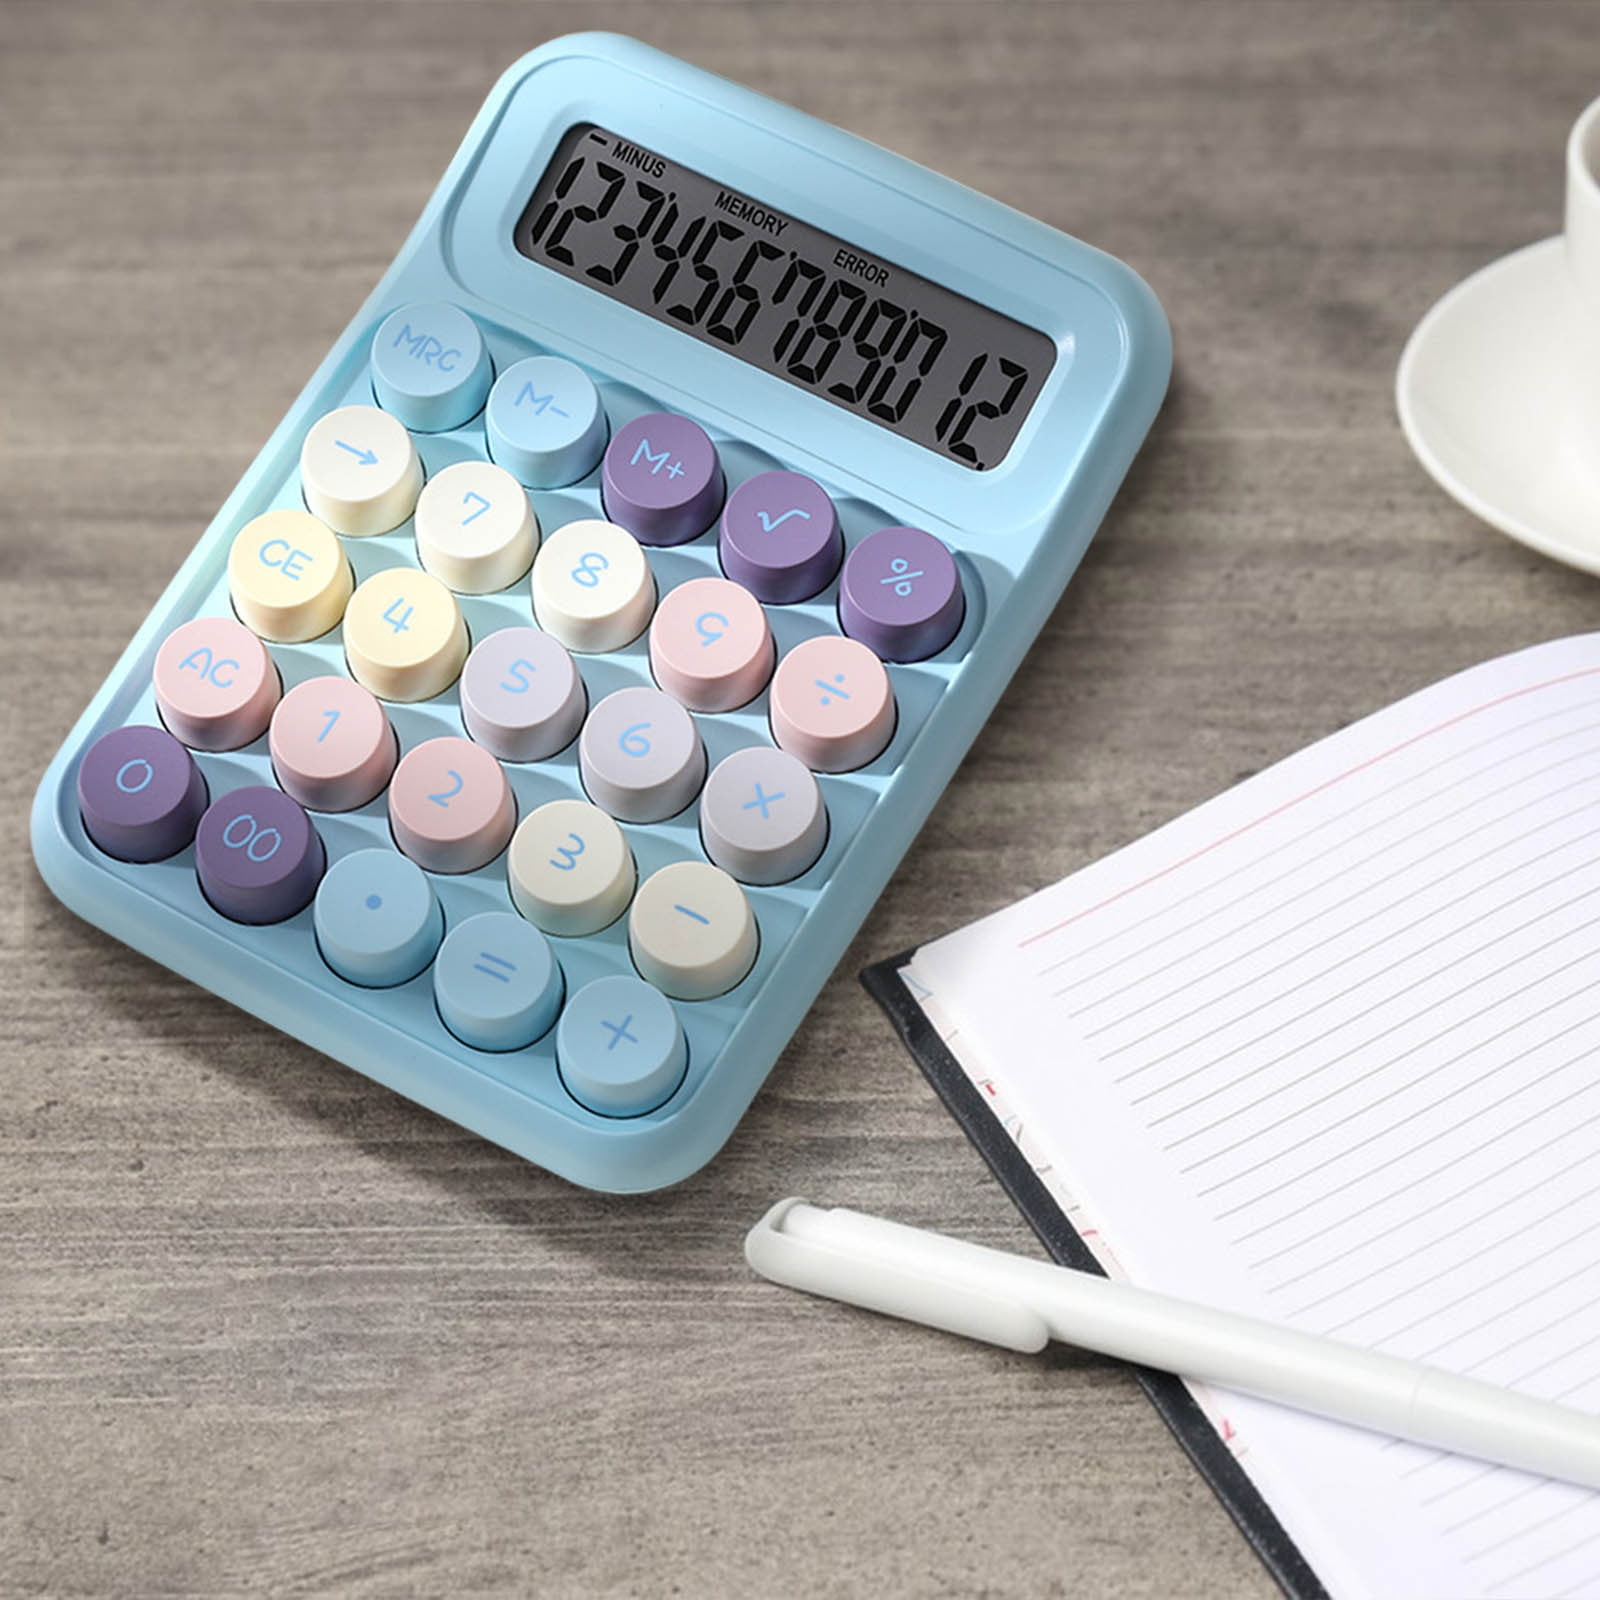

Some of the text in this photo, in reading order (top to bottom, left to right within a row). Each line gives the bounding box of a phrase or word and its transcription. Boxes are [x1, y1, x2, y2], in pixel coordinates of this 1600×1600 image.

[612, 142, 666, 179] MINUS
[715, 191, 789, 237] MEMORY
[833, 249, 890, 287] ERROR
[394, 323, 462, 373] MRC
[515, 381, 570, 419] M-
[631, 440, 684, 479] M+
[462, 493, 491, 525] 7
[259, 539, 313, 580] CE
[571, 553, 608, 587] 8
[881, 559, 923, 596] %
[383, 598, 413, 633] 4
[696, 612, 728, 646] 9
[178, 648, 240, 688] AC
[500, 660, 535, 693] 5
[317, 710, 340, 742] 1
[618, 723, 650, 757] 6
[116, 759, 153, 793] 0
[428, 770, 463, 807] 2
[223, 814, 282, 862] 00
[550, 834, 585, 870] 3
[600, 1014, 639, 1050] +
